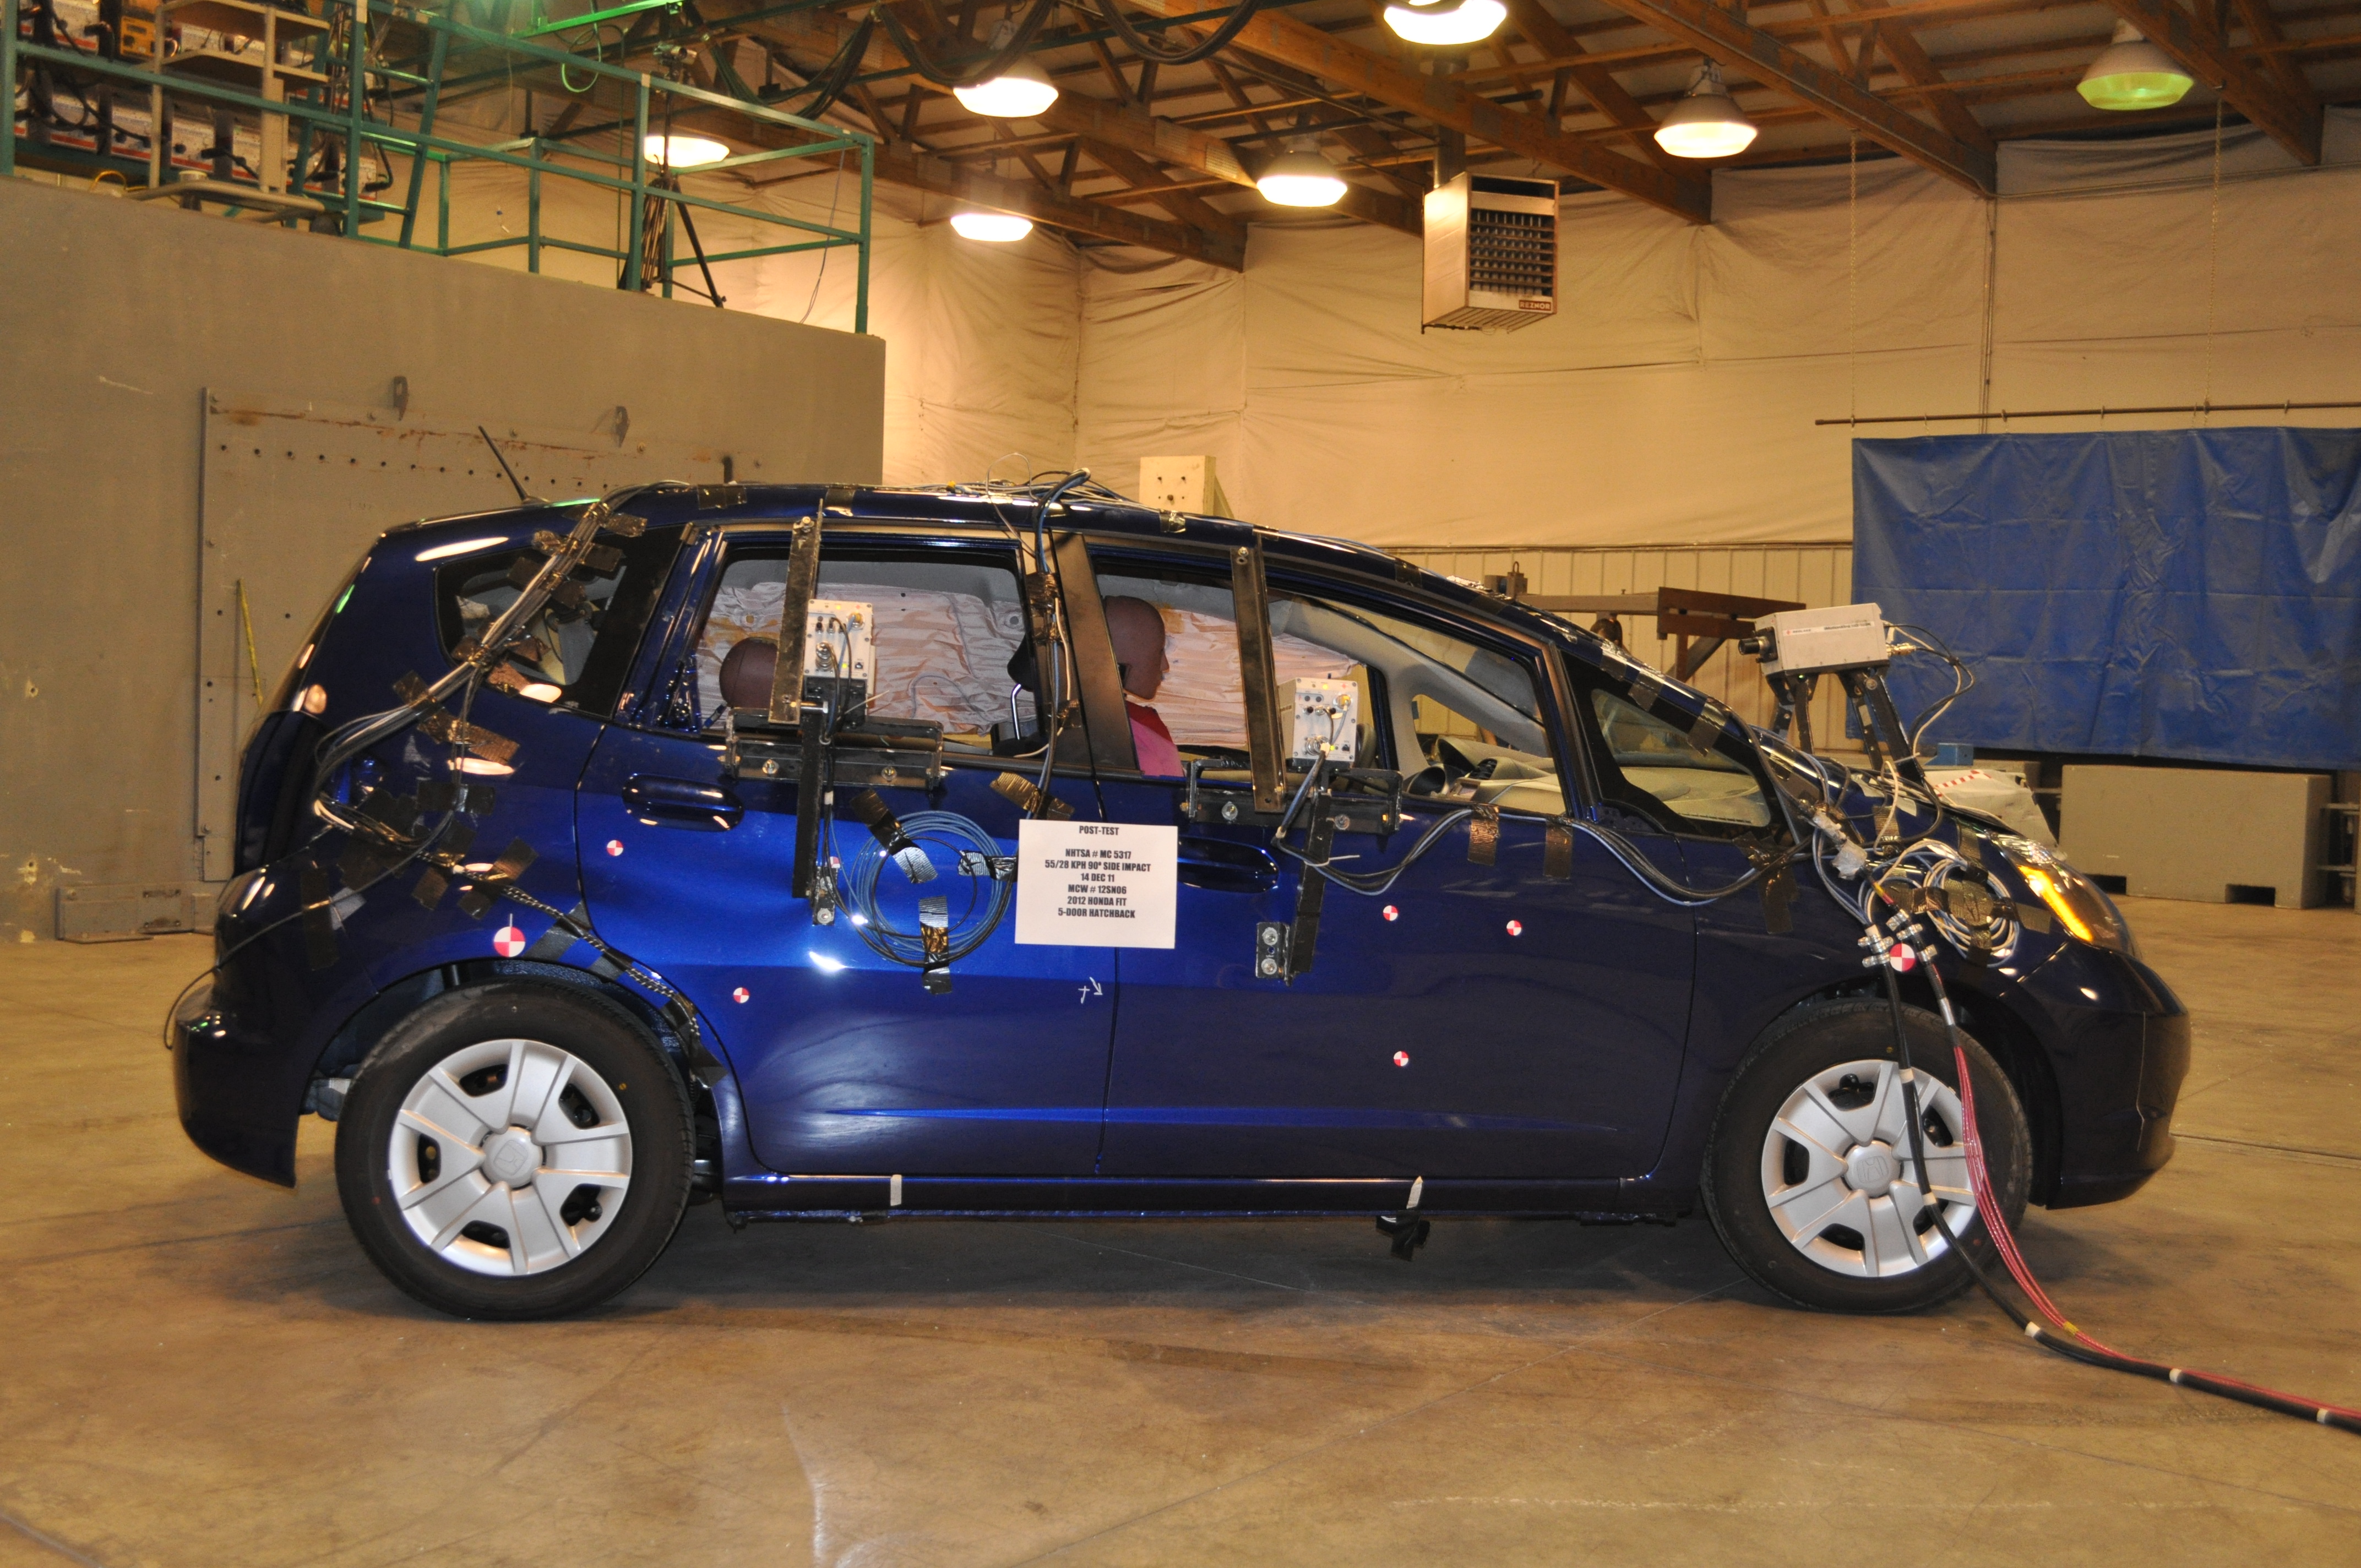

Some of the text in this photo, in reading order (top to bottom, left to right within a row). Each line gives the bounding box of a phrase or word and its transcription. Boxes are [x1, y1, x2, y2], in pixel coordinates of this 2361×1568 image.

[1079, 825, 1119, 835] POST-TEST
[1065, 848, 1090, 857] NHTSA
[1100, 850, 1112, 858] MC
[1114, 851, 1131, 859] 5317
[1045, 859, 1069, 868] 55/28
[1071, 861, 1086, 869] KPH
[1103, 862, 1120, 870] SIDE
[1122, 863, 1151, 872] IMPACT
[1091, 873, 1106, 881] DEC
[1068, 884, 1088, 892] MCW
[1068, 896, 1127, 906] 2012 HONDA FIT
[1058, 908, 1135, 918] 5-DOOR HATCHBACK
